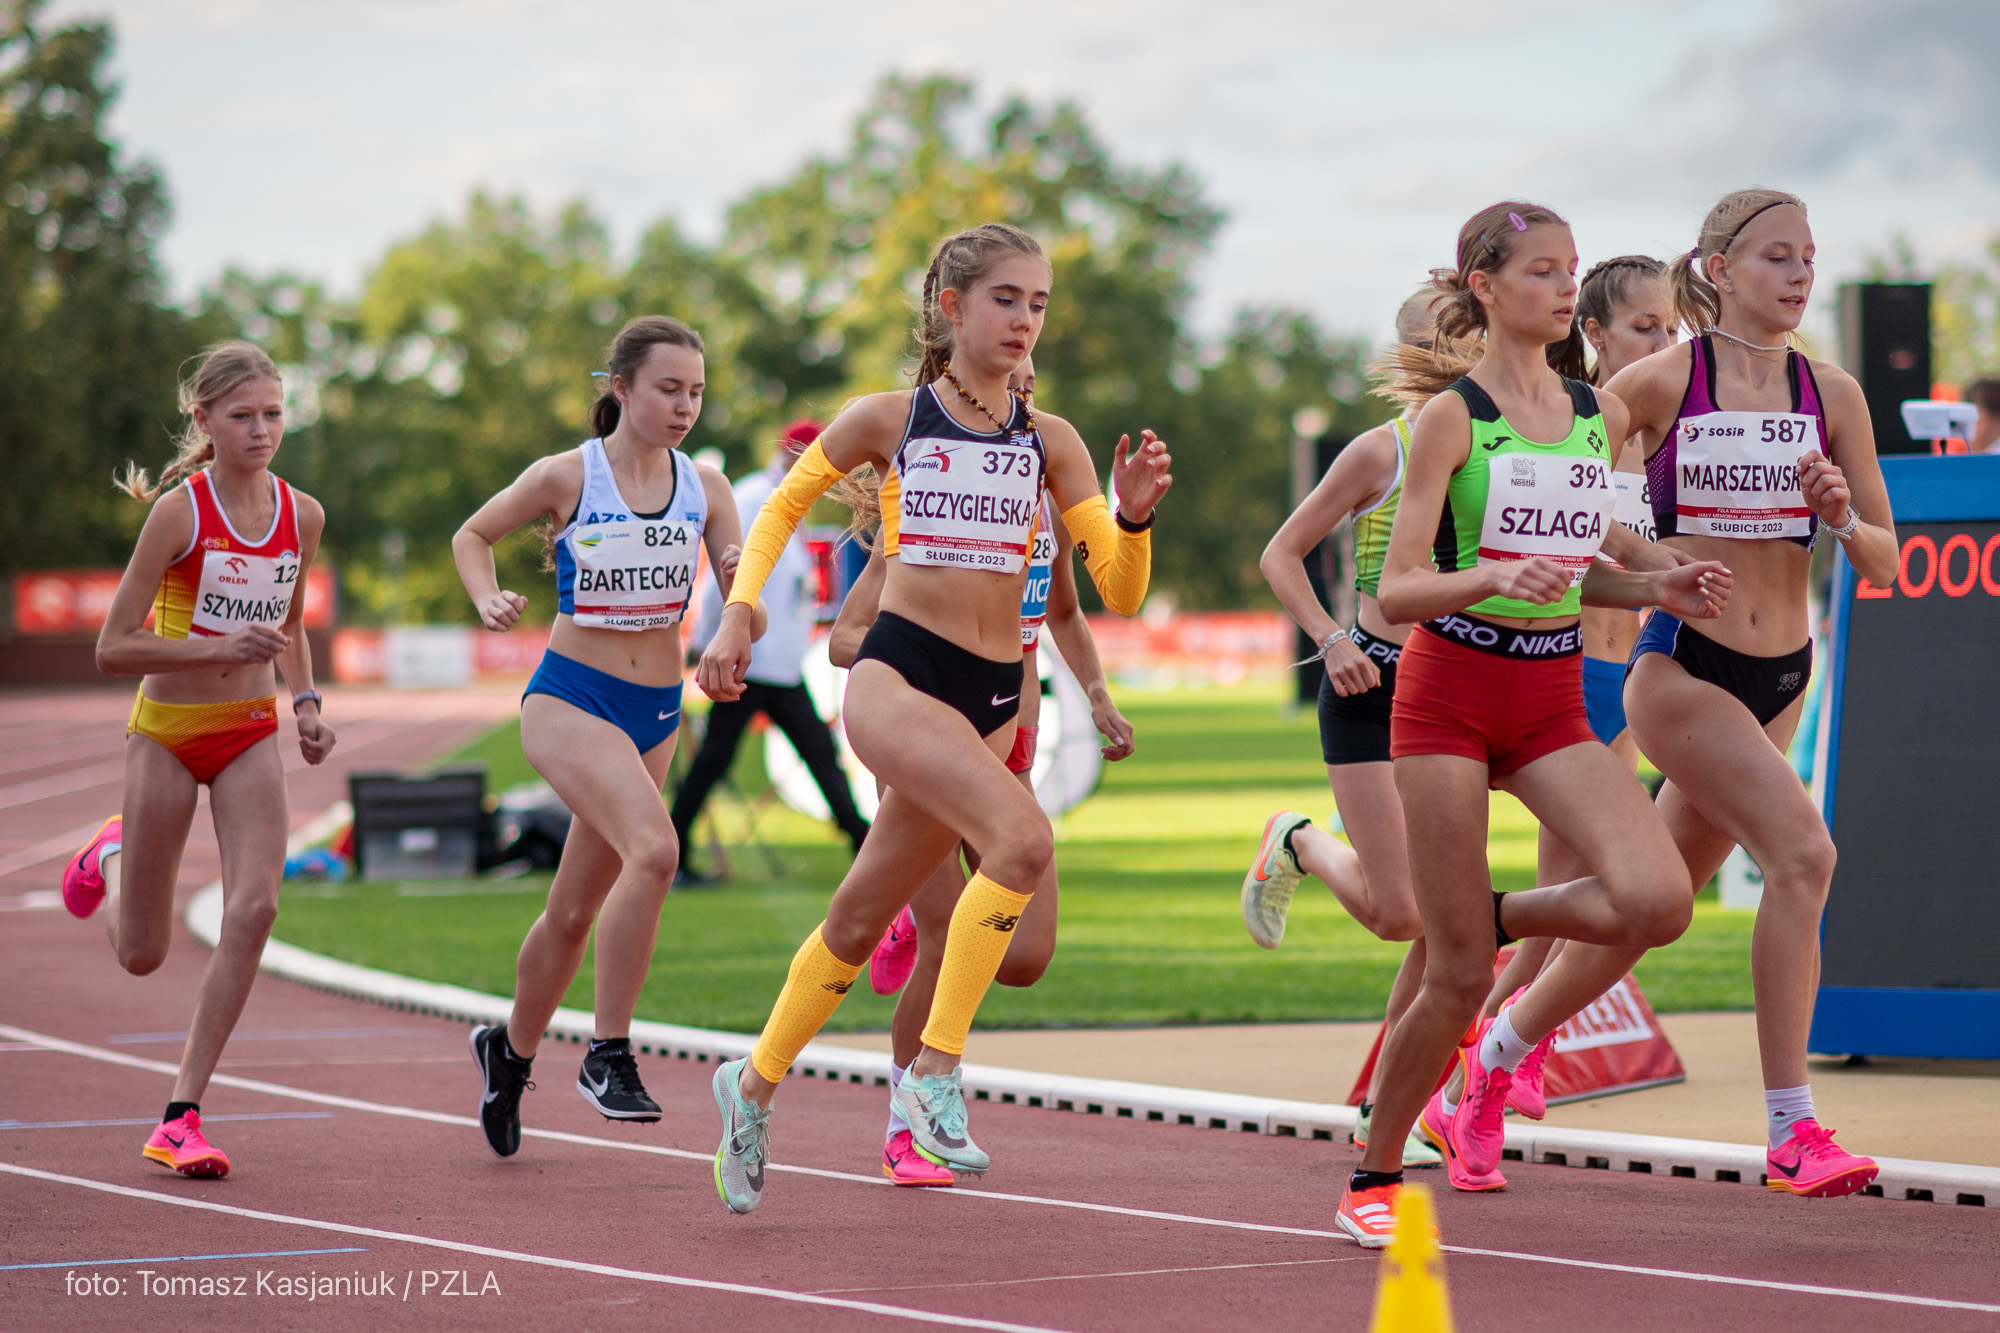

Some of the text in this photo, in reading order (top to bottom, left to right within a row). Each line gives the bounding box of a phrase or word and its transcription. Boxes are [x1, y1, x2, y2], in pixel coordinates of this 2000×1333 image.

[1760, 419, 1807, 443] 587
[908, 460, 940, 471] polanik
[982, 451, 1031, 477] 373
[1569, 463, 1608, 489] 391
[905, 490, 1031, 527] SZCZYGIELSKA
[1498, 506, 1600, 539] SZLAGA
[1710, 522, 1783, 533] SŁUBICE 2023
[644, 525, 688, 547] 824
[925, 550, 1006, 566] SŁUBICE 2023
[218, 575, 249, 585] ORLEN
[274, 564, 298, 584] 12
[579, 564, 689, 592] BARTECKA
[647, 616, 669, 626] 2023
[1508, 630, 1576, 655] NIKE
